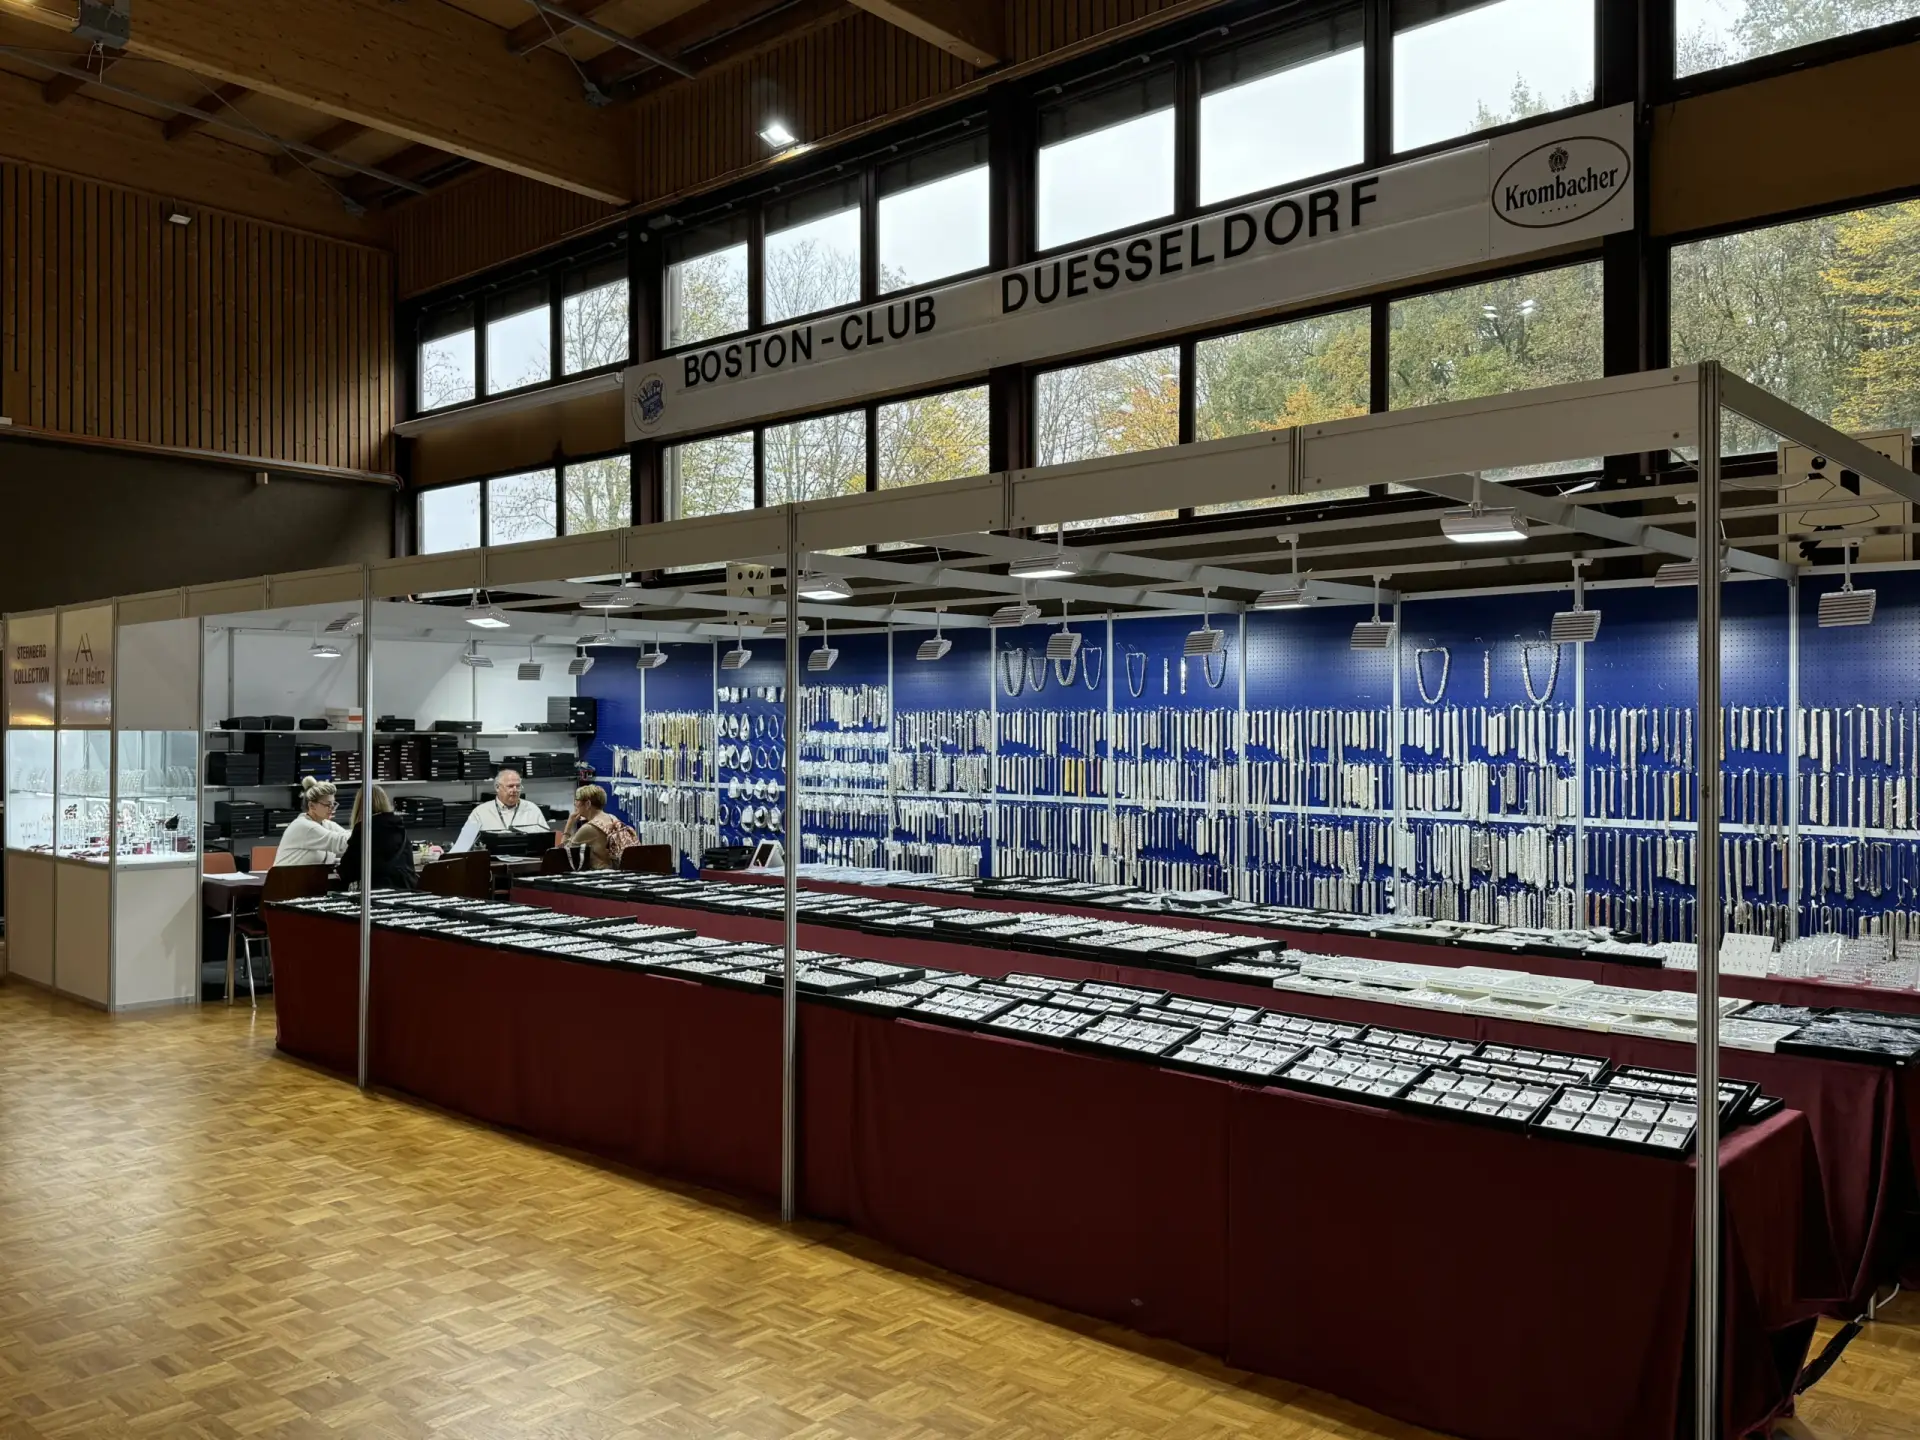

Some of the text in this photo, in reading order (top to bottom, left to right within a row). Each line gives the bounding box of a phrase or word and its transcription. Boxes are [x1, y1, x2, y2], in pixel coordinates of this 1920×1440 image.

[1505, 167, 1618, 211] Krombacher
[684, 176, 1379, 388] BOSTON-CLUB DUESSELDORF
[17, 644, 46, 659] STERNBERG
[14, 667, 49, 684] COLLECTION
